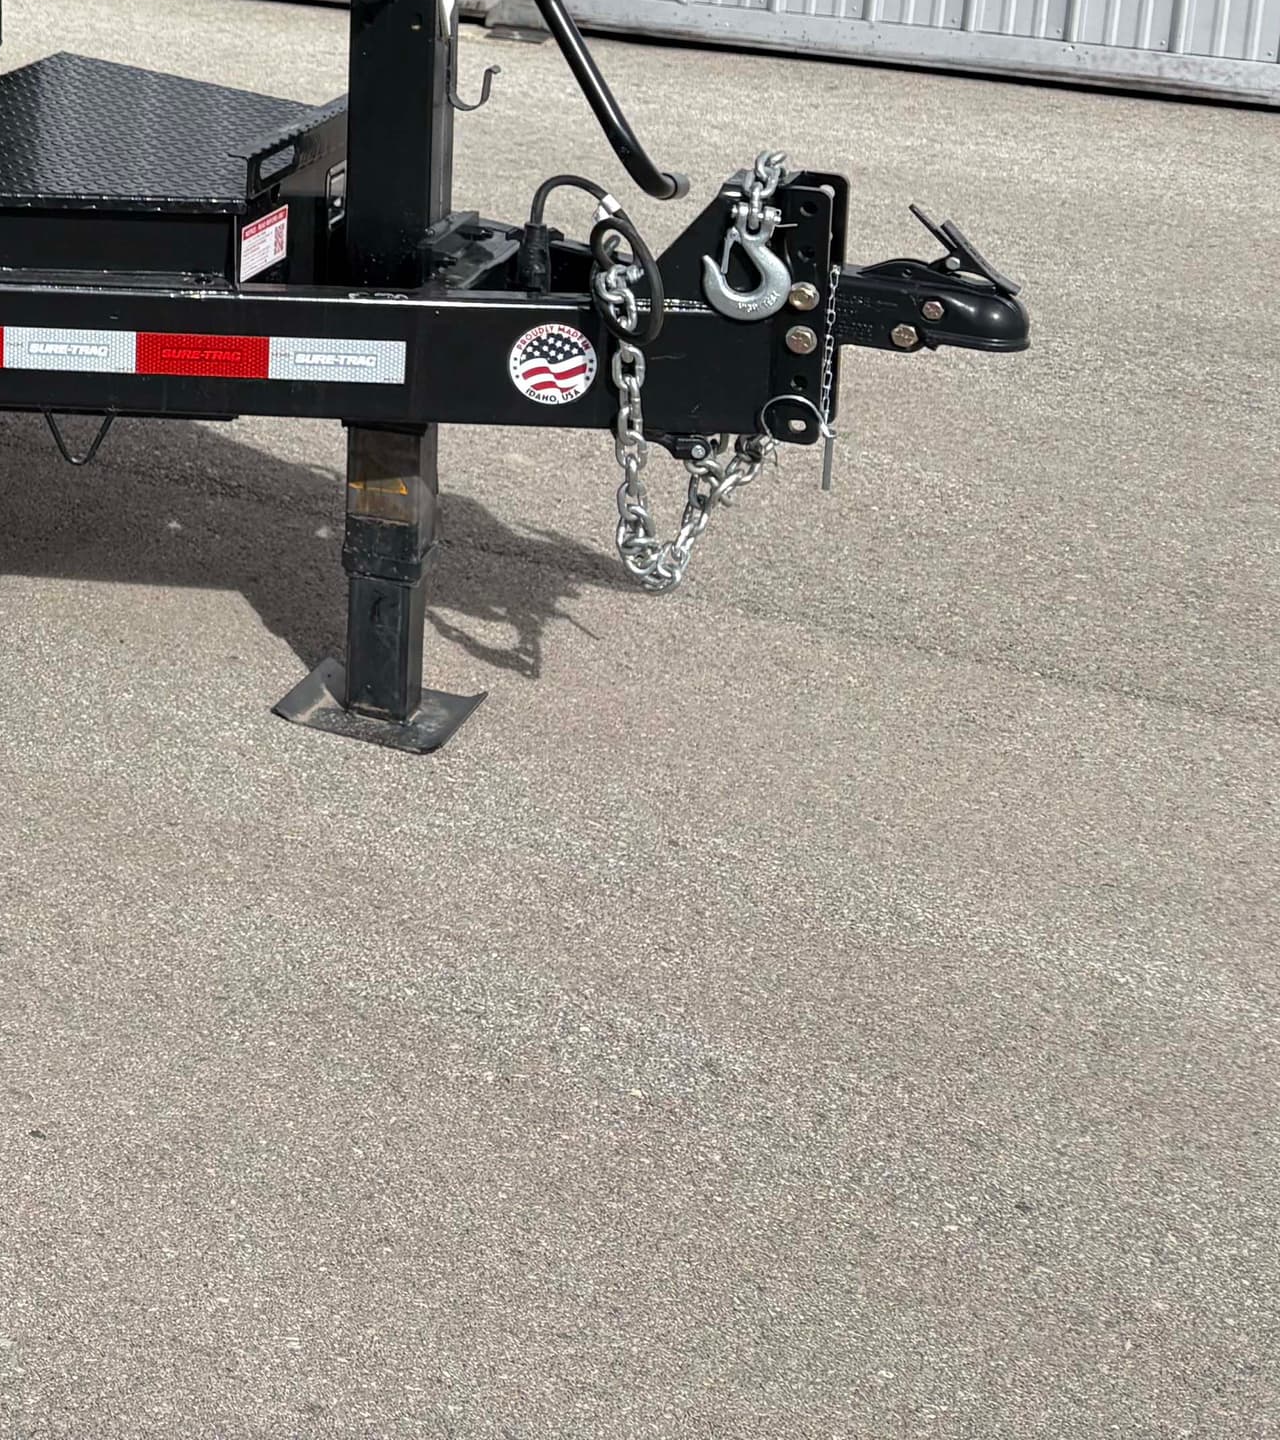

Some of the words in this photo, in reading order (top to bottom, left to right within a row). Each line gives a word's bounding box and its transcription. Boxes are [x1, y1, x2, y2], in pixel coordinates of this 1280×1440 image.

[516, 325, 554, 350] PROUDLY
[558, 326, 584, 341] MADE
[581, 340, 591, 351] IN
[29, 342, 109, 357] SURE-TRAC
[162, 348, 241, 361] SURE-TRAC
[294, 352, 376, 367] SURE-TRAC
[525, 388, 560, 404] IDAHO,
[562, 389, 581, 401] USA
